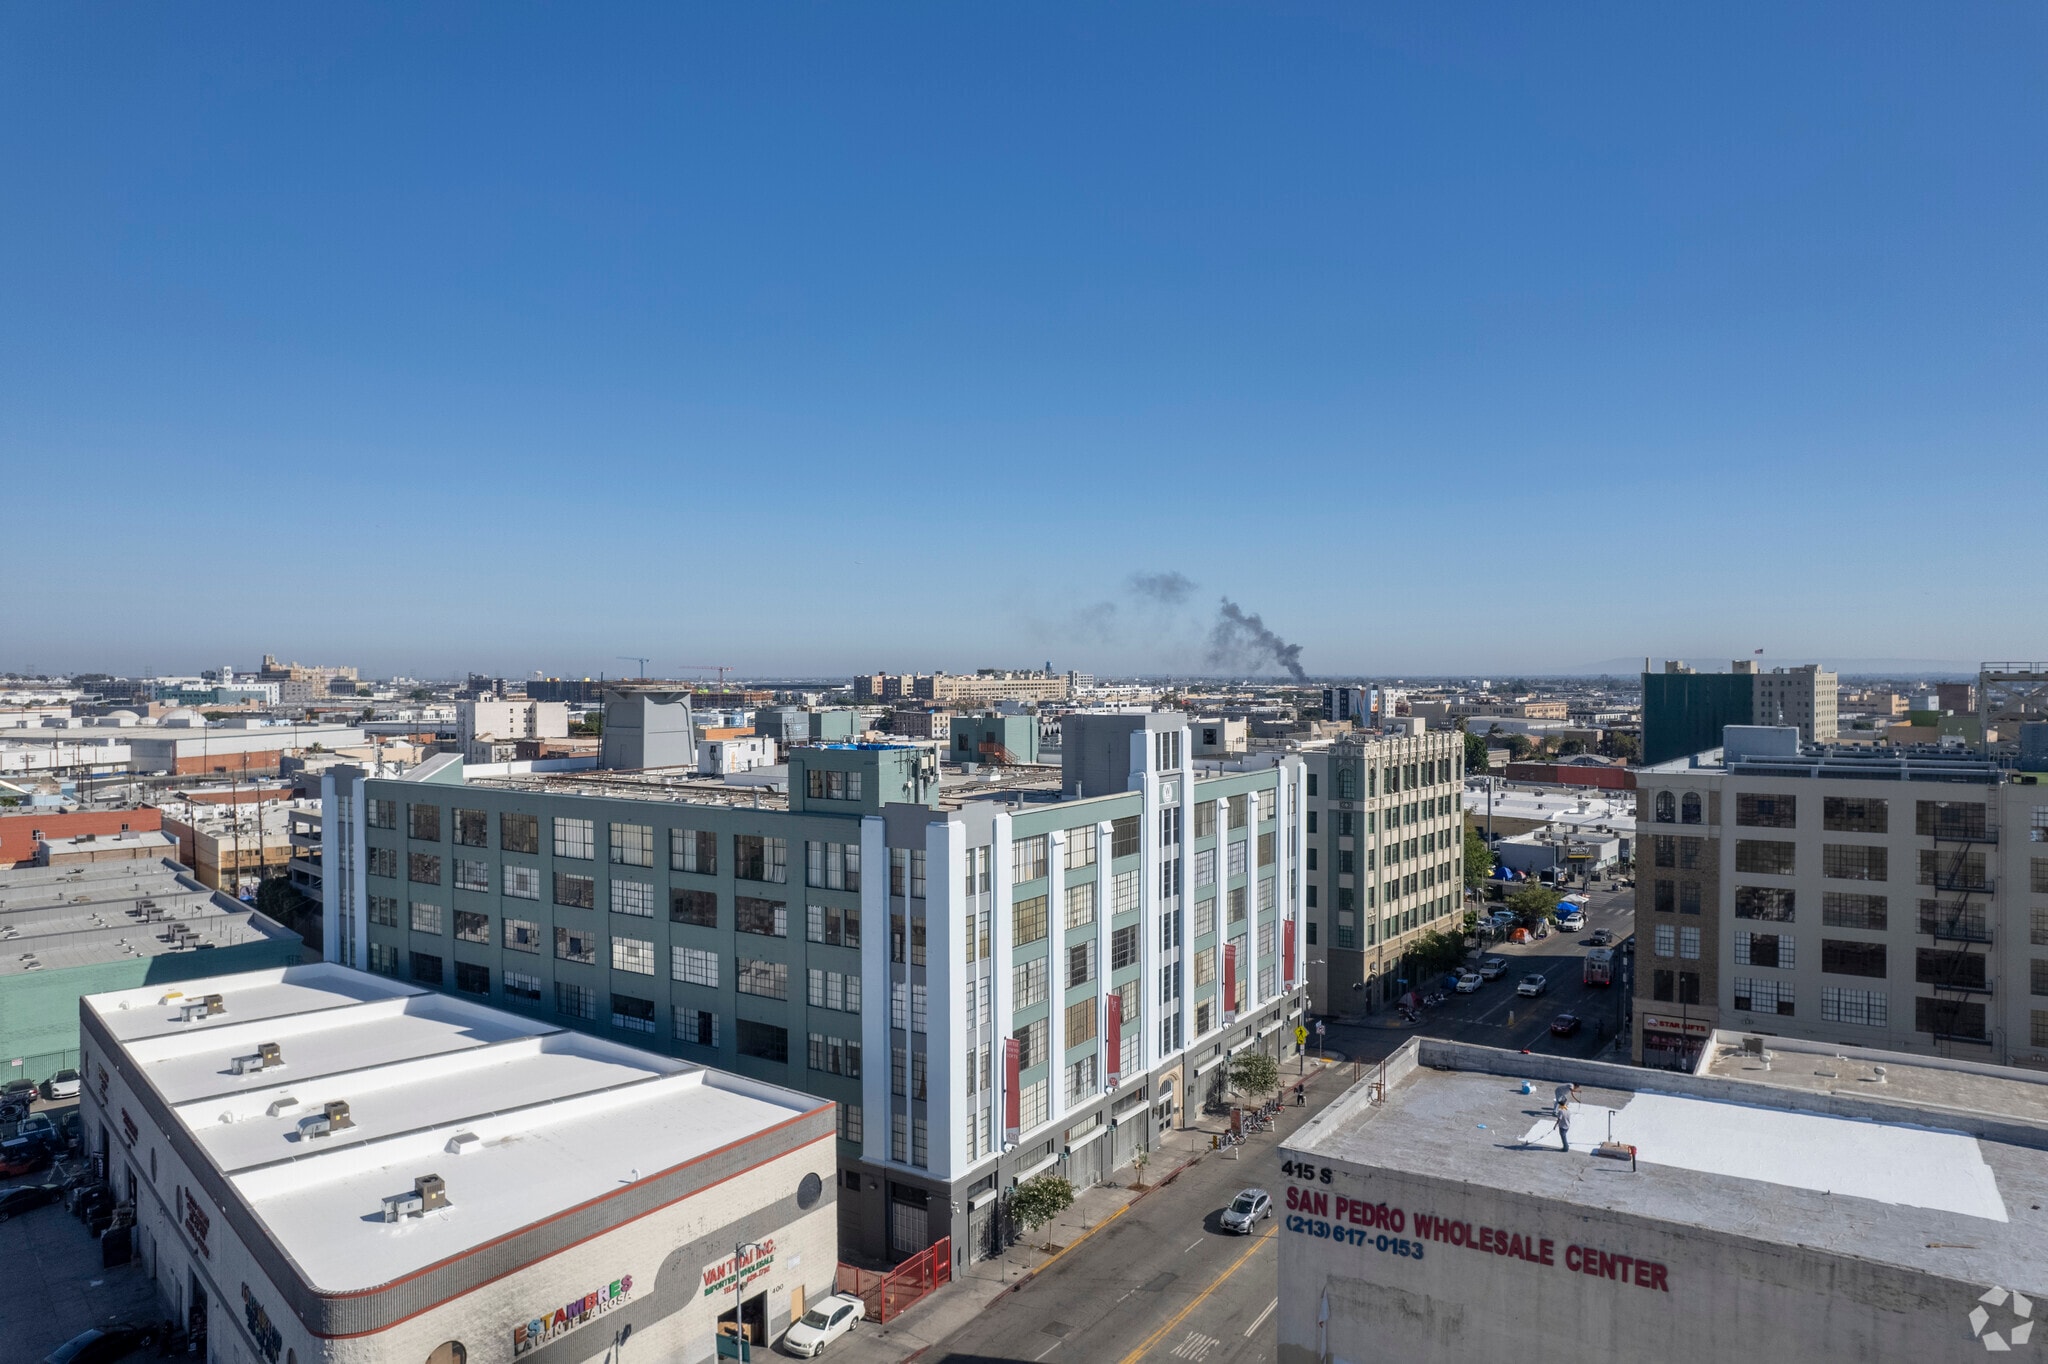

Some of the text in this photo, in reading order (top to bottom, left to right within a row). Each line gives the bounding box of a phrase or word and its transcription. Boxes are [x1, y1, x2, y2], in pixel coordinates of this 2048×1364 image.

[1659, 1021, 1680, 1029] STAR
[1281, 1160, 1333, 1184] 415 S
[1286, 1186, 1669, 1293] SAN PEDRO WHOLESALE CENTER
[703, 1263, 726, 1287] VAN
[740, 1254, 775, 1278] WHOLESALE
[771, 1283, 784, 1294] 400
[514, 1274, 633, 1346] ESTAMBRES
[514, 1290, 632, 1357] LA PANTERA ROSA
